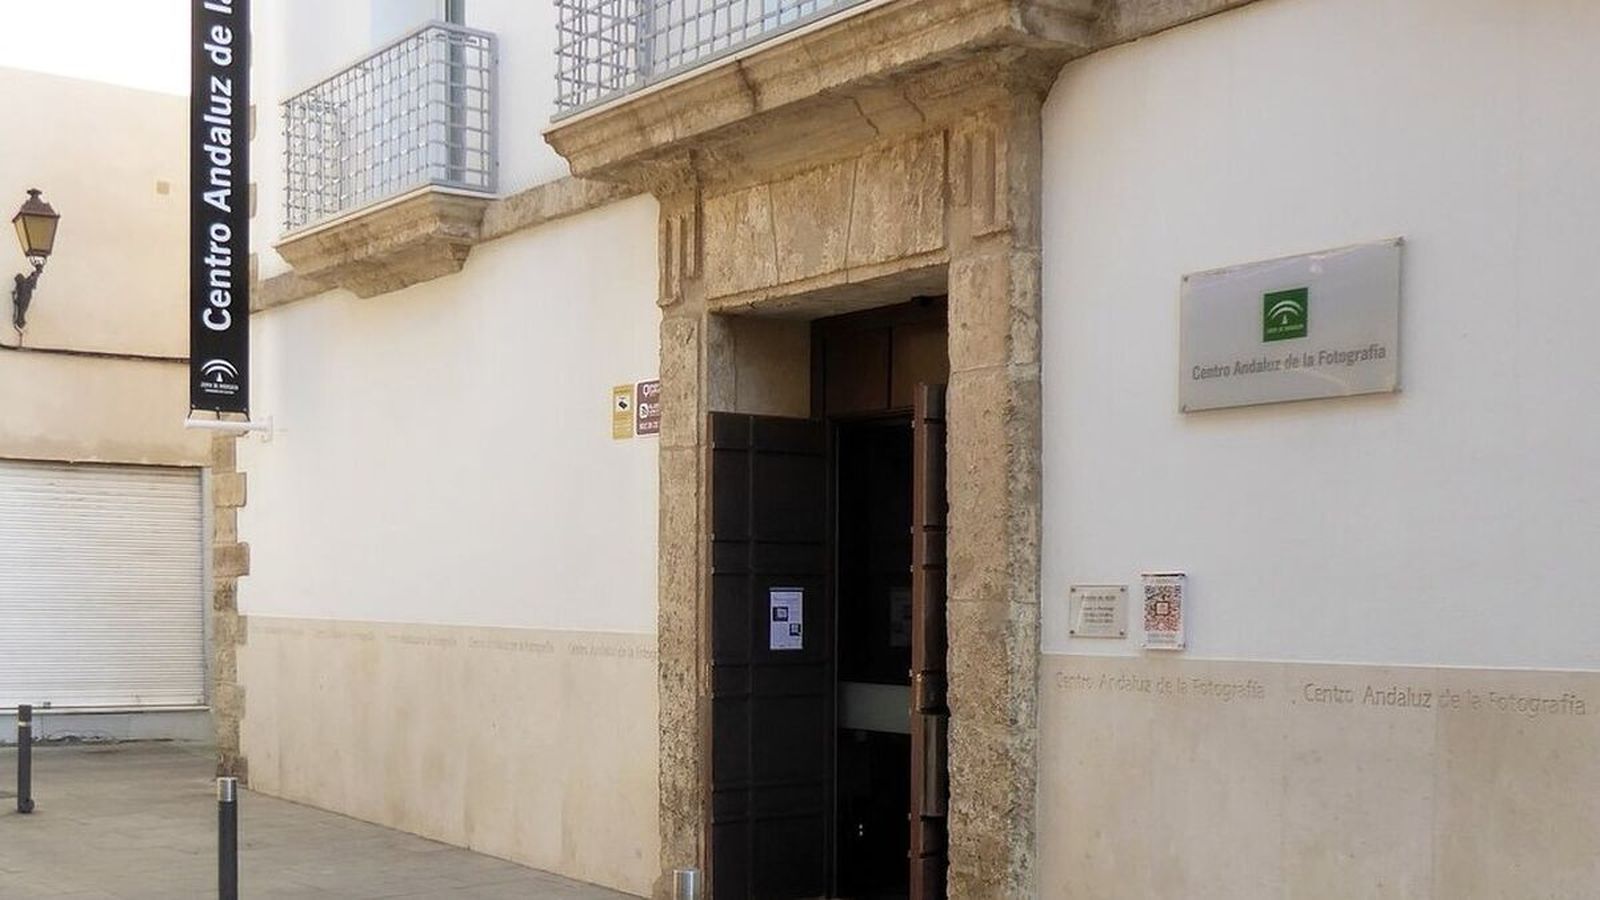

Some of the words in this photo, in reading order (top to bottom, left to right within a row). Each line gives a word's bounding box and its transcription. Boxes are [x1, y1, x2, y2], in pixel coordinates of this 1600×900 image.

[203, 0, 232, 14] l
[203, 25, 233, 66] de
[203, 75, 232, 213] Andaluz
[202, 222, 232, 331] Centro
[1192, 364, 1231, 380] Centro
[1233, 354, 1281, 376] Andaluz
[1284, 352, 1299, 369] de
[1302, 352, 1314, 368] la
[1304, 682, 1354, 702] Centro
[1363, 685, 1432, 708] Andaluz
[1438, 688, 1460, 709] de
